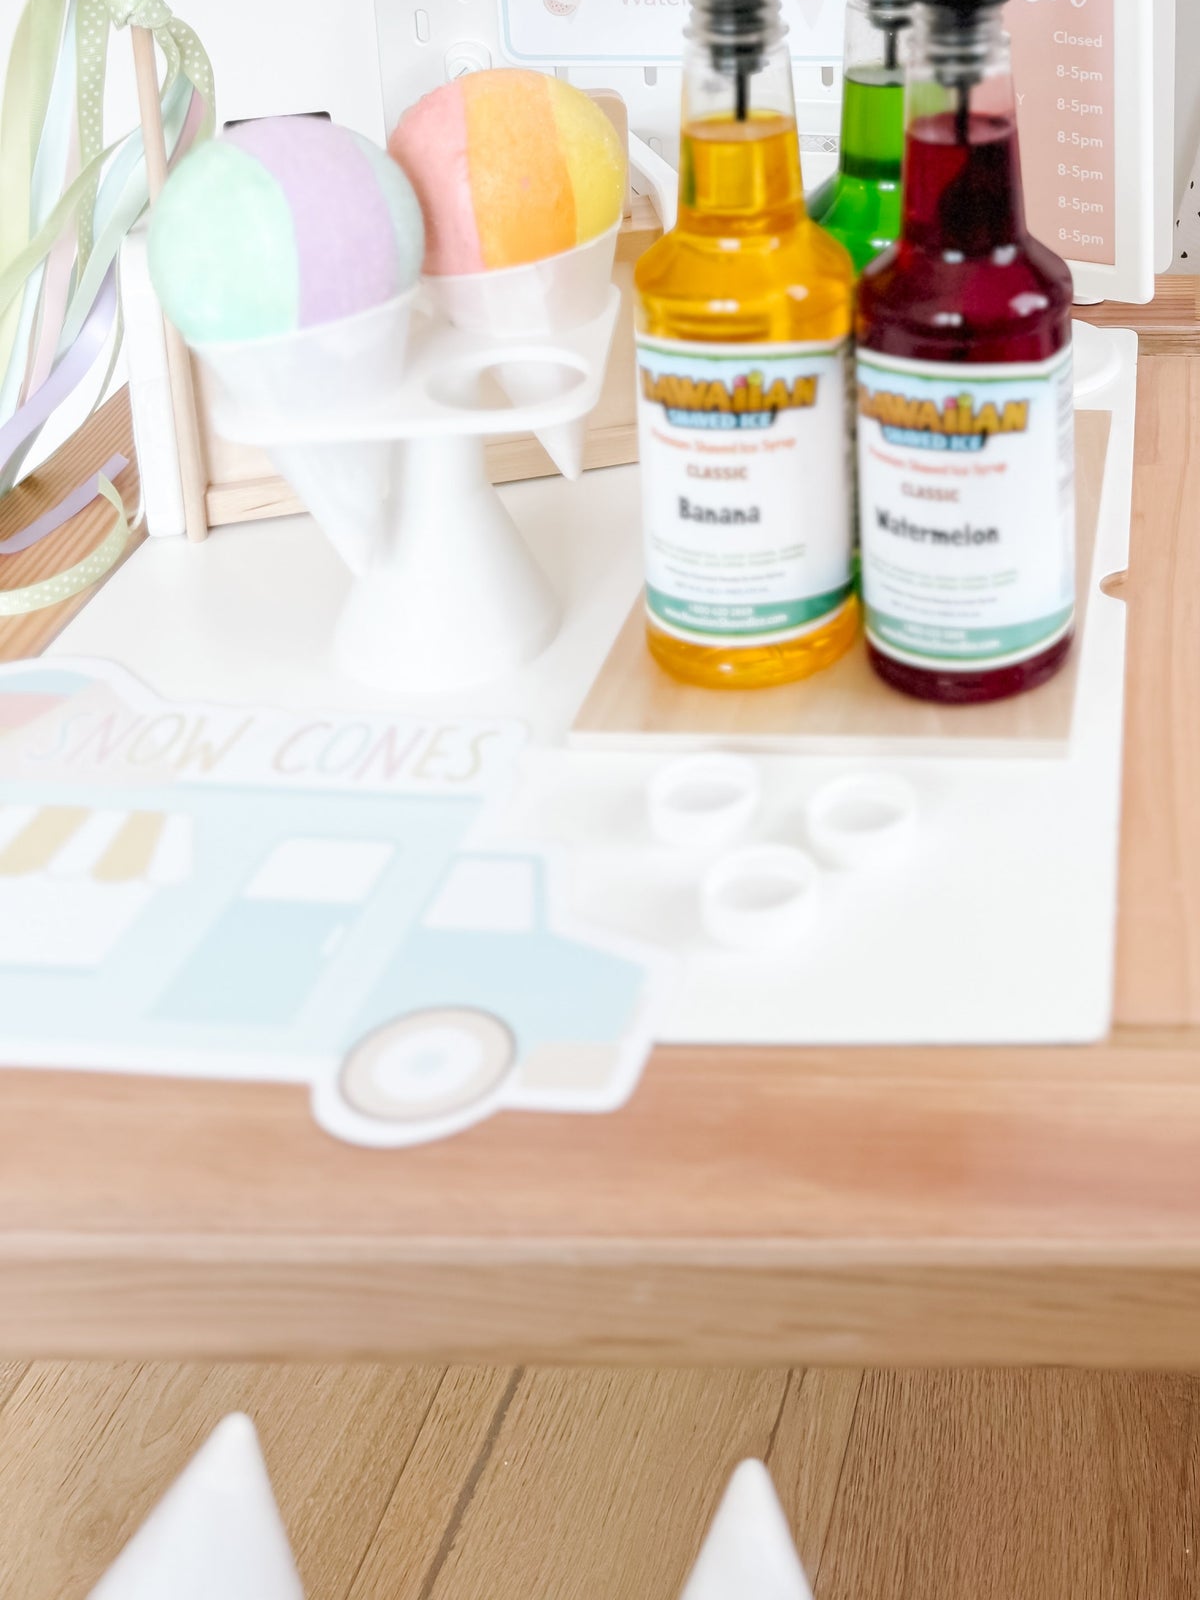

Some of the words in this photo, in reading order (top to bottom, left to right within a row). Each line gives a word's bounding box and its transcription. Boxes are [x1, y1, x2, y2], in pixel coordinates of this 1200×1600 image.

[1053, 31, 1103, 48] Closed
[1056, 64, 1103, 83] 8-5pm
[1056, 97, 1103, 116] 8-5pm
[1057, 130, 1103, 149] 8-5pm
[1057, 163, 1103, 182] 8-5pm
[1058, 196, 1104, 214] 8-5pm
[1058, 228, 1104, 246] 8-5pm
[685, 463, 750, 481] CLASSIC
[899, 481, 961, 503] CLASSIC
[676, 495, 762, 526] Banana
[873, 505, 1002, 548] Watermelon
[27, 711, 255, 773] SNOW
[271, 720, 503, 783] CONES
